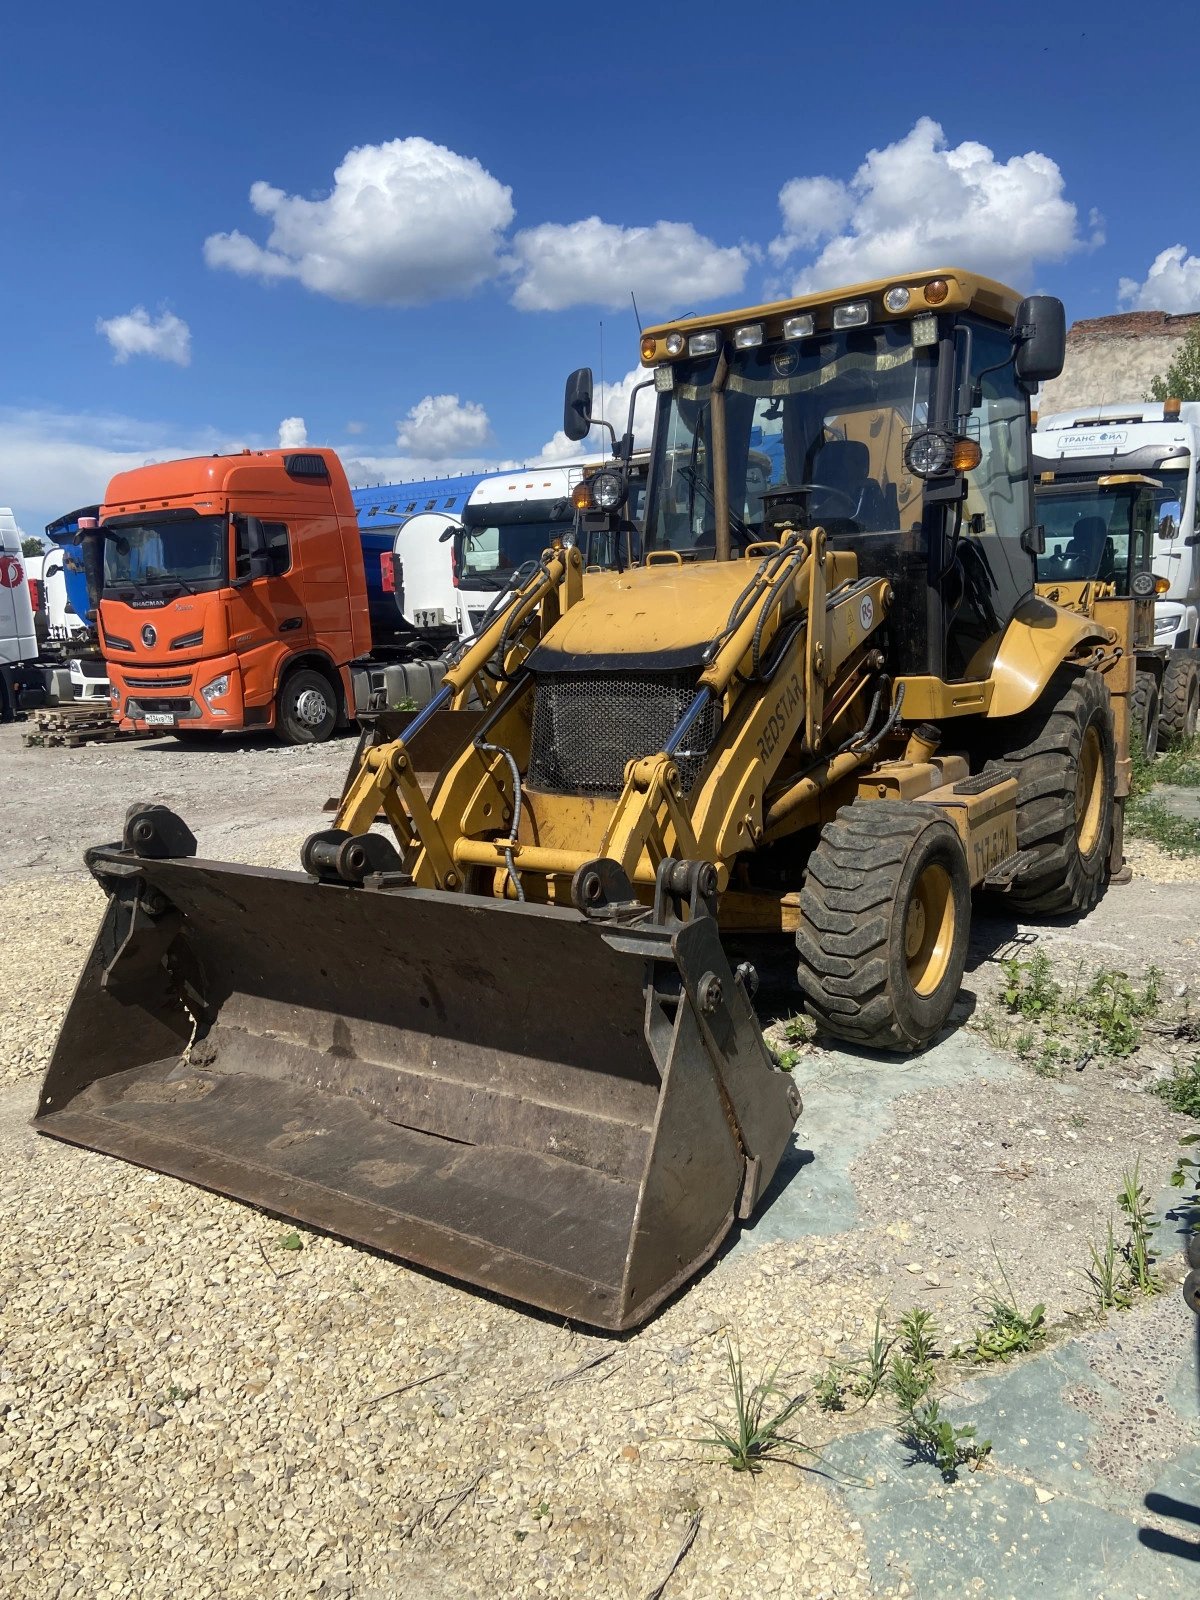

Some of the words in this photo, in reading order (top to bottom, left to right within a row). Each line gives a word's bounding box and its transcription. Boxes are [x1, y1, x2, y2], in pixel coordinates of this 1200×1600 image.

[1064, 435, 1096, 443] ТРАНС
[861, 603, 873, 621] RS
[757, 673, 803, 766] REDSTAR
